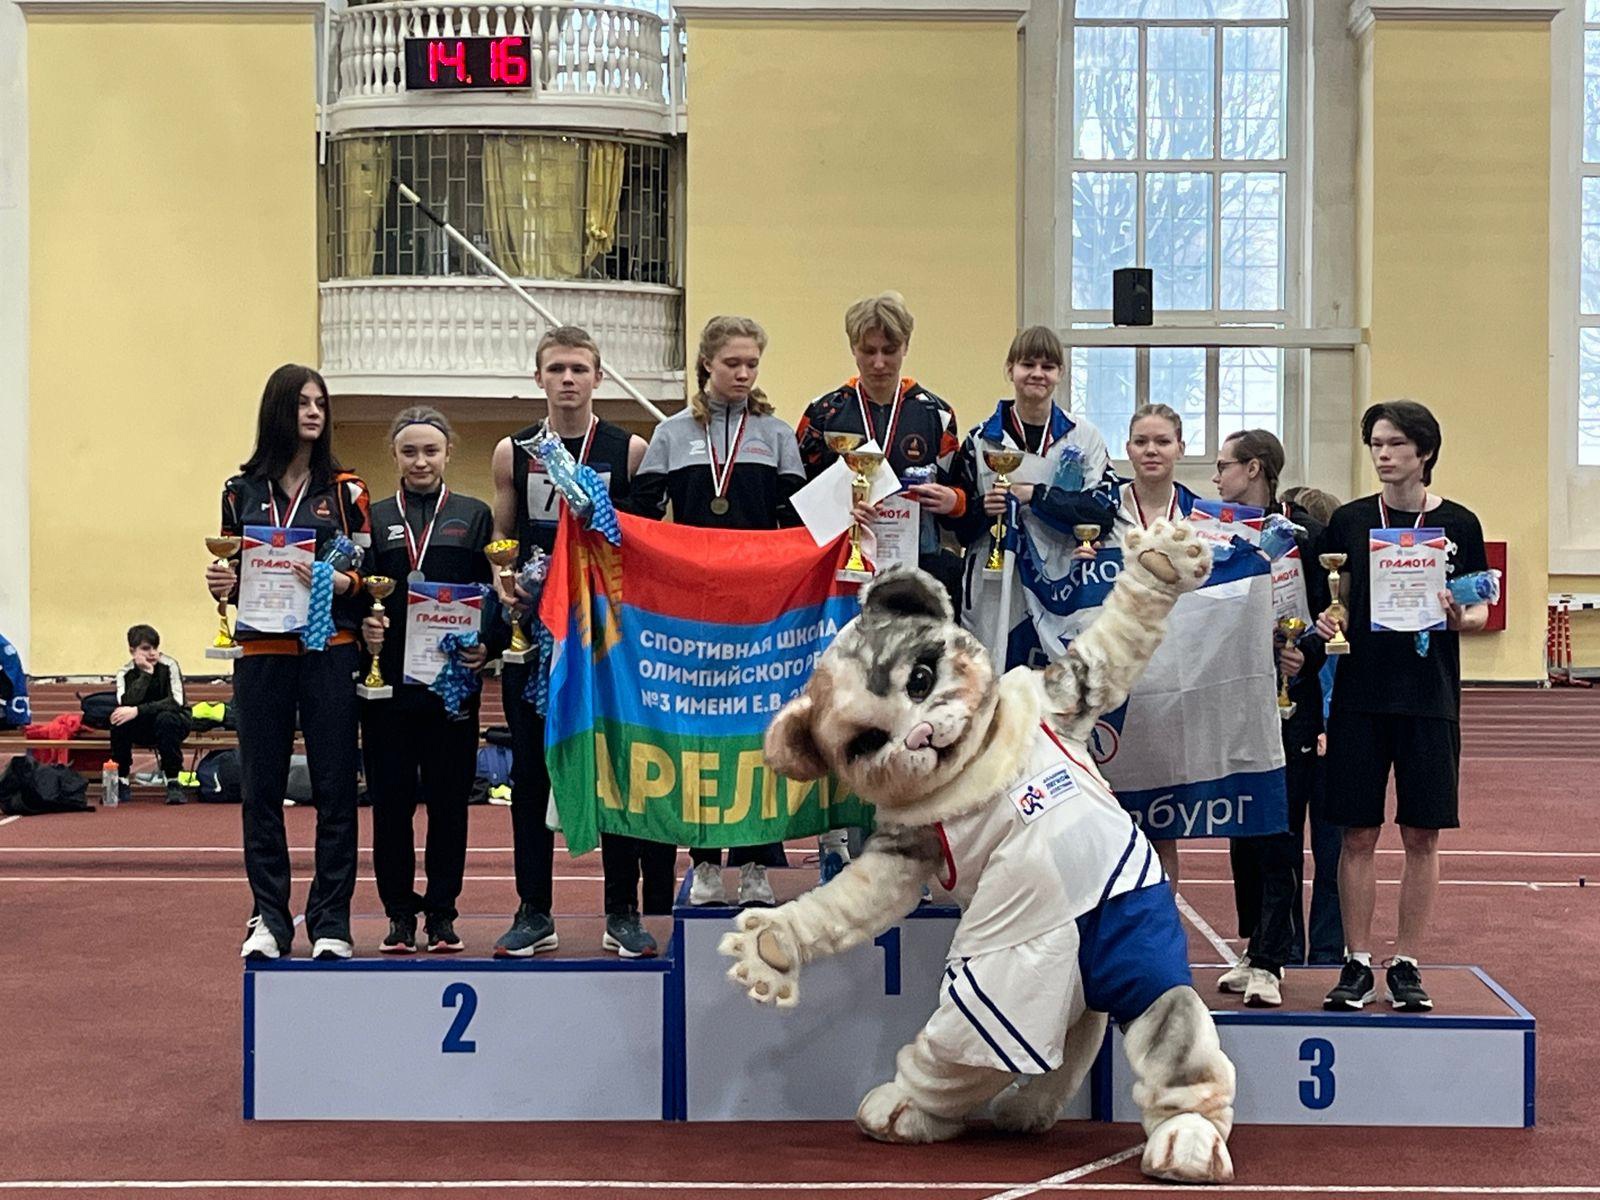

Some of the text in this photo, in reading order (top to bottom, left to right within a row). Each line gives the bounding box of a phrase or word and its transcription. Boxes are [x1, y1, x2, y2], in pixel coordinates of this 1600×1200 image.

[1379, 557, 1436, 569] ГРАМОТА
[416, 613, 472, 625] ГРАМОТА
[640, 617, 838, 661] СПОРТИВНАЯ ШКОЛА
[639, 657, 804, 688] ОЛИМПИЙСКОГО
[642, 689, 670, 712] №3
[674, 695, 748, 716] ИМЕНИ
[874, 926, 901, 995] 1
[441, 982, 478, 1053] 2
[1298, 1037, 1336, 1110] 3
